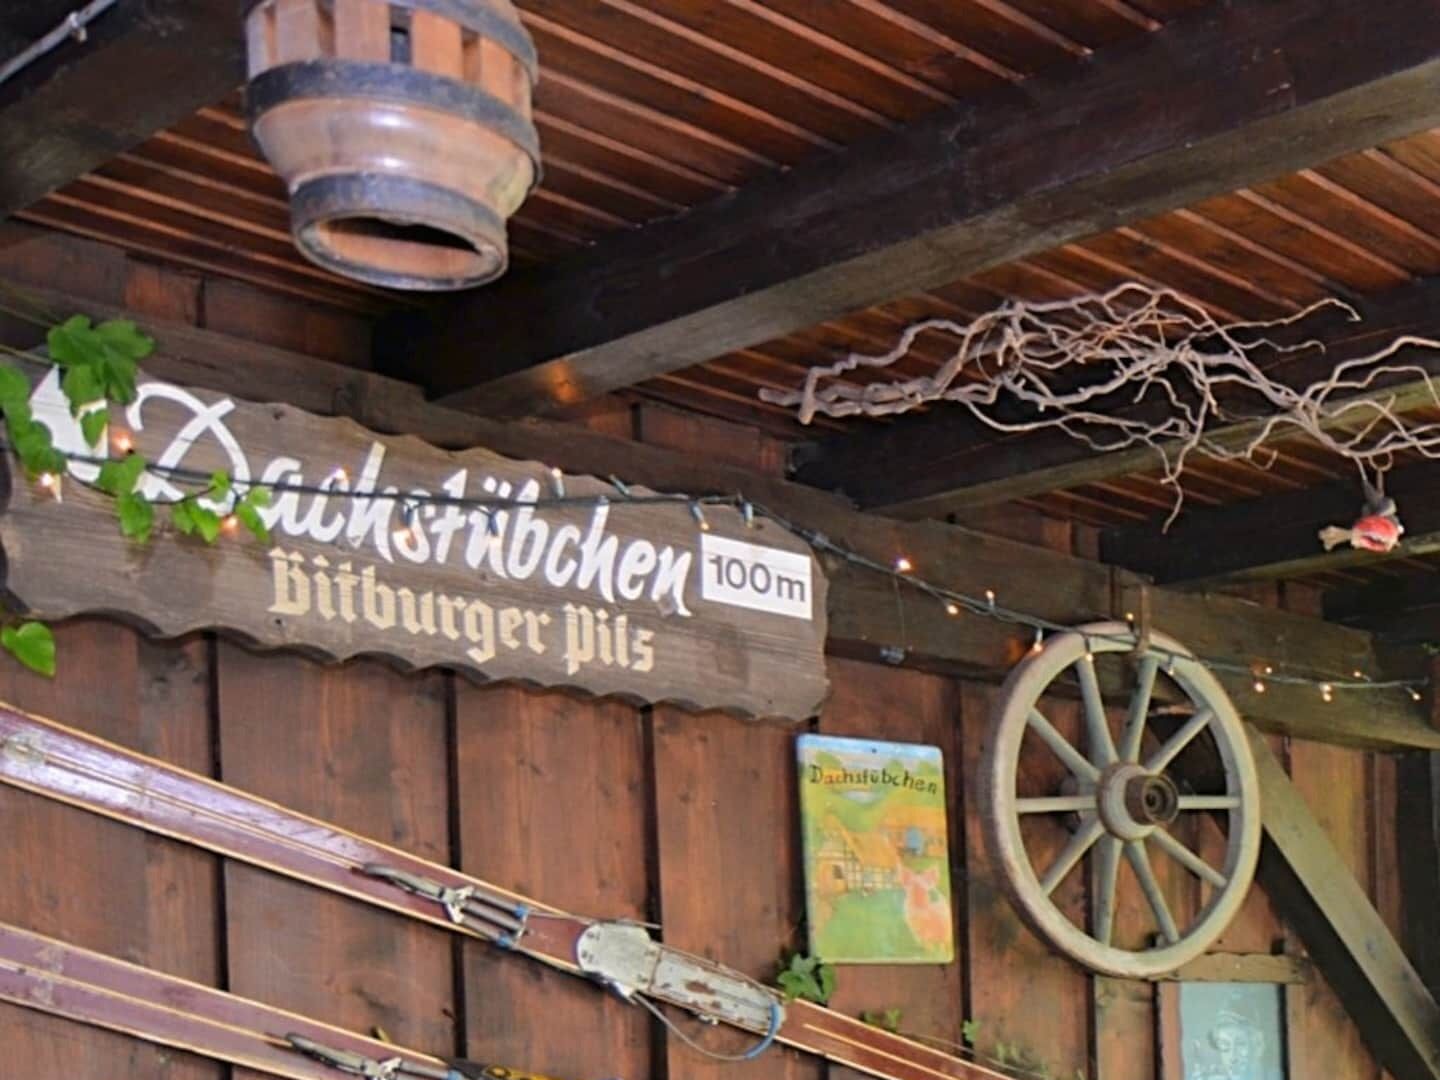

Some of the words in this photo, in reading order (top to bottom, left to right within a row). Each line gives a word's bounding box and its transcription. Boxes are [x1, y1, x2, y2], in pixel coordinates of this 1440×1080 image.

[268, 546, 552, 664] Bitburger
[563, 602, 656, 675] Pils
[810, 765, 937, 794] Dachstübchen
